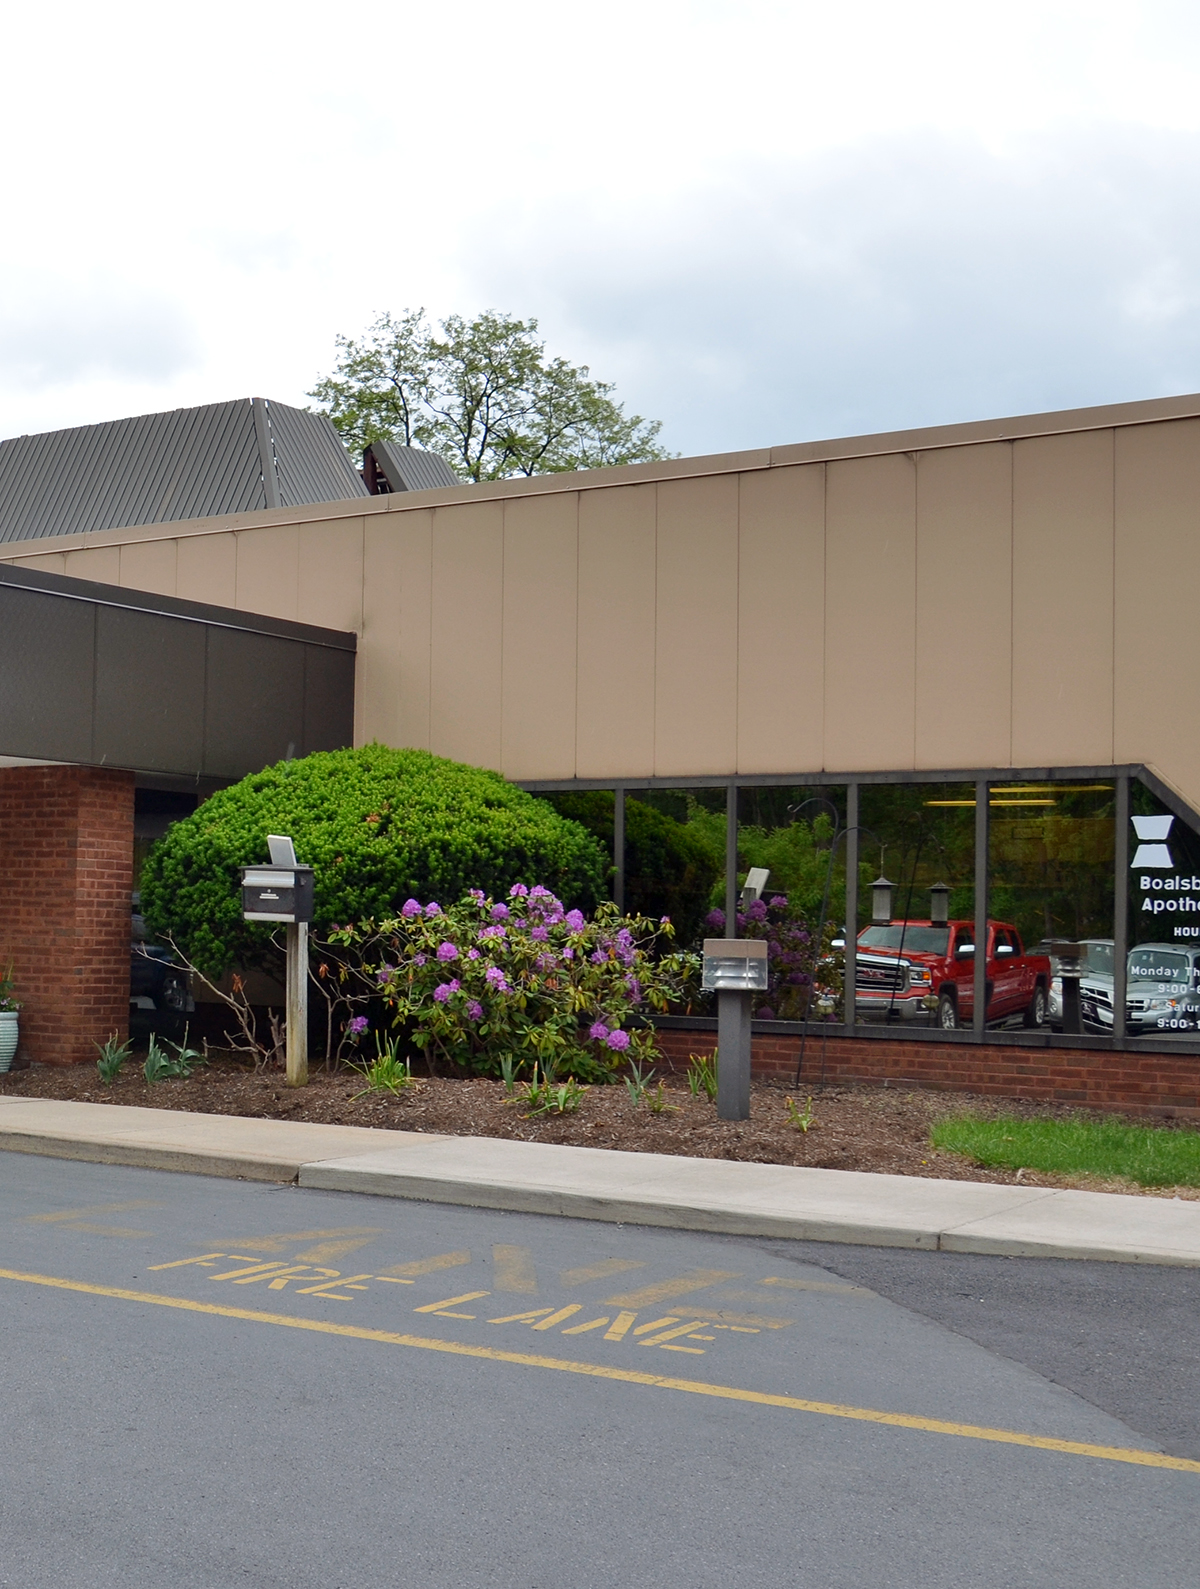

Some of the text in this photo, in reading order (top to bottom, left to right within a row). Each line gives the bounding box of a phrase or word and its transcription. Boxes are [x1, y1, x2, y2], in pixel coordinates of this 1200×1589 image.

[1130, 965, 1180, 978] Monday
[146, 1252, 762, 1355] FIRE LANE
